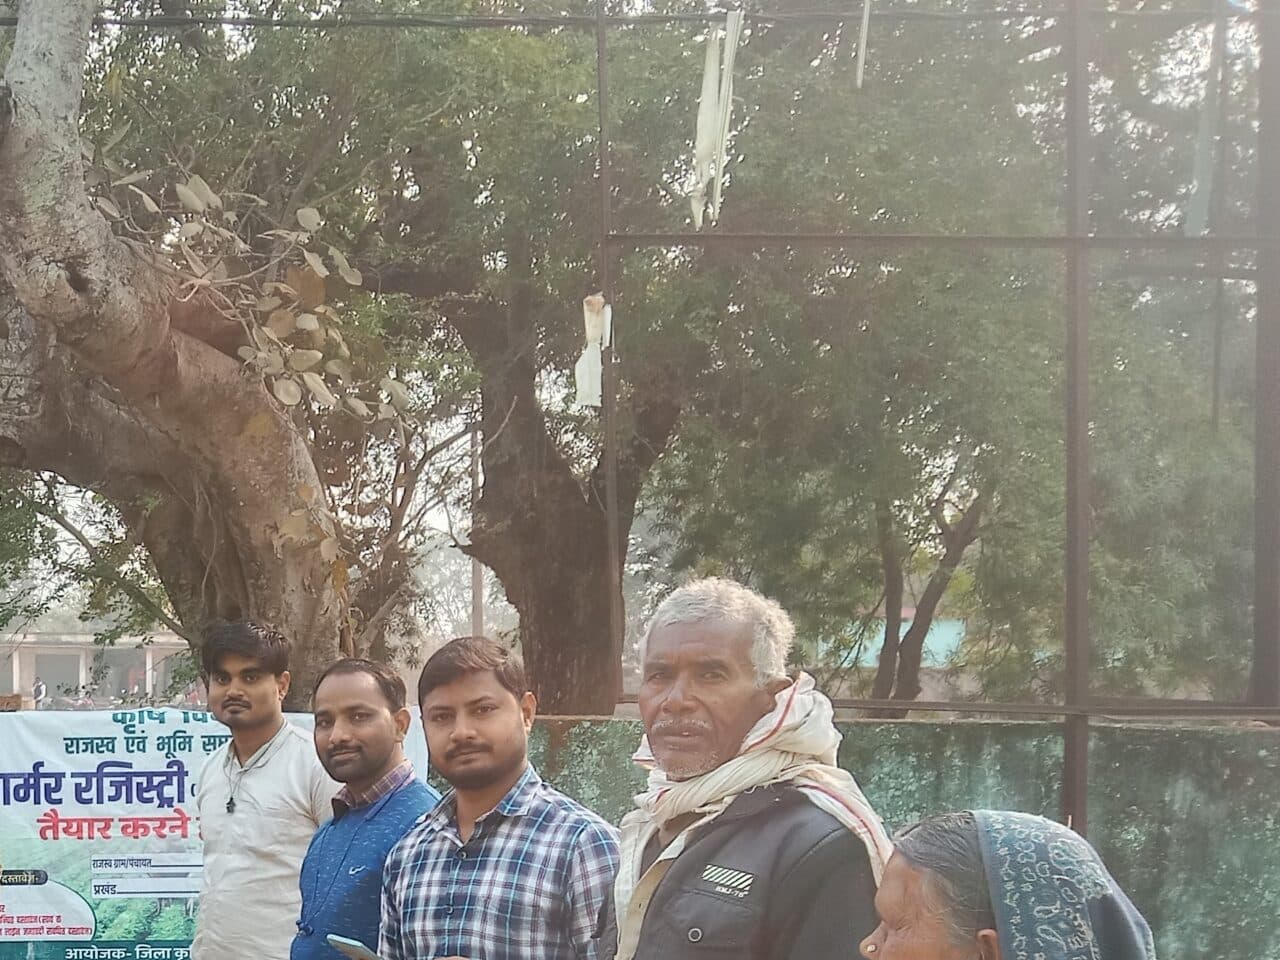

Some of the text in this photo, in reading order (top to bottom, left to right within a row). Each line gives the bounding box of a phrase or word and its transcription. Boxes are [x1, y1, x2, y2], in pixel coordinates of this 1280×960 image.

[63, 736, 117, 754] राजस्व
[124, 730, 148, 754] एवं
[156, 730, 194, 759] भूमि
[71, 760, 189, 808] रजिस्ट्री
[37, 808, 192, 841] तैयार करने
[92, 859, 113, 869] राजस्व
[65, 945, 132, 960] आयोजक-
[134, 944, 173, 960] जिला
